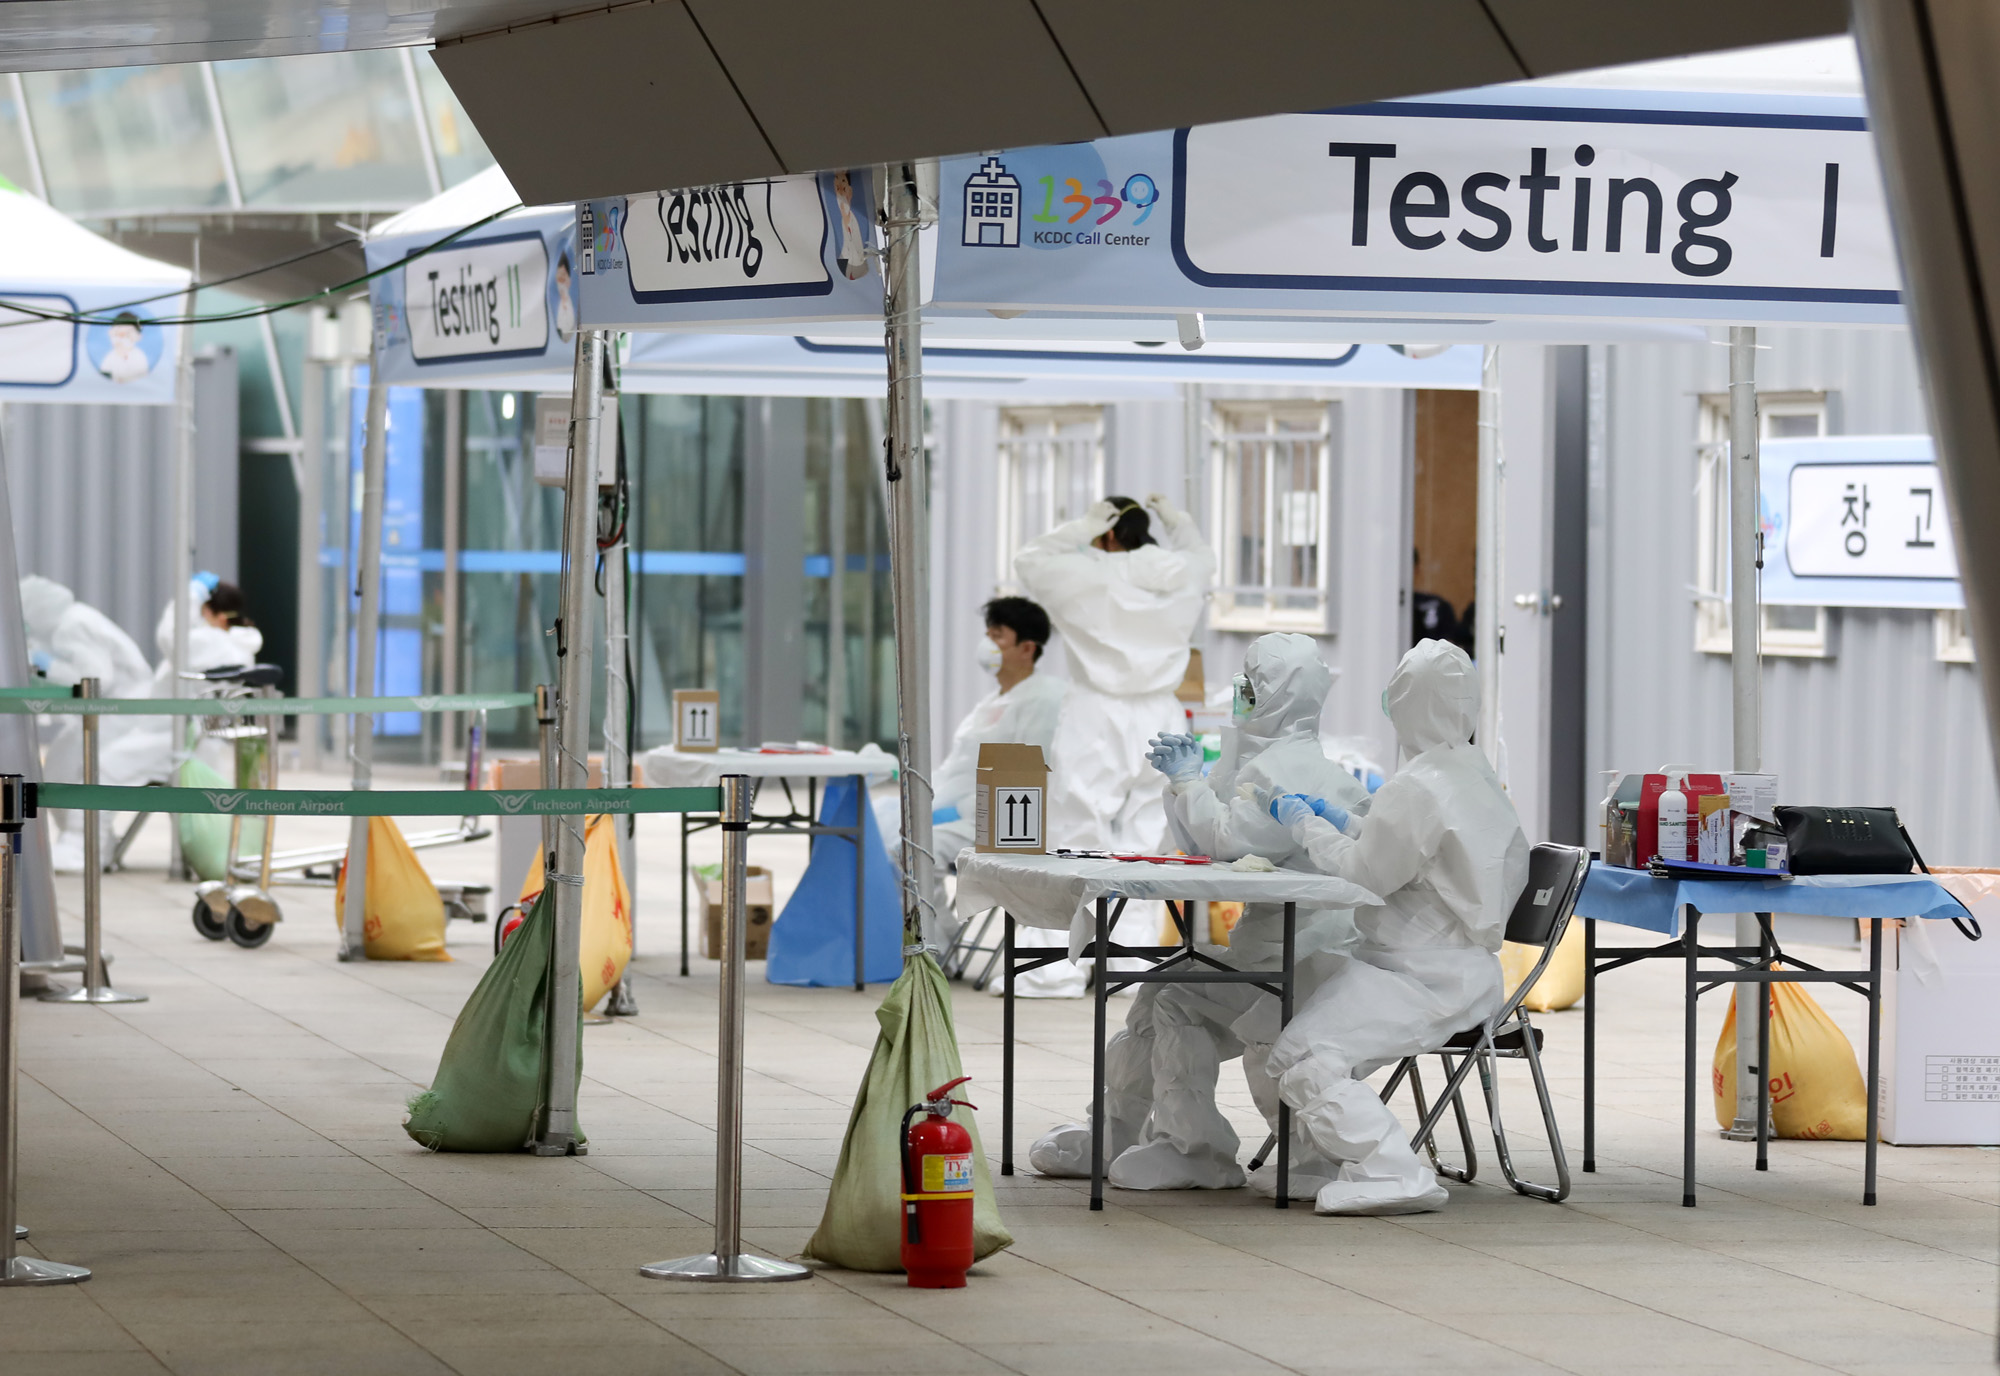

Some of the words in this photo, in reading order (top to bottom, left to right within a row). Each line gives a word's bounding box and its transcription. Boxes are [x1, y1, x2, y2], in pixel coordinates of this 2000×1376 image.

[1032, 173, 1160, 227] 1339
[1328, 142, 1740, 278] Testing
[1034, 231, 1073, 245] KCDC
[1076, 231, 1101, 245] Call
[1104, 232, 1151, 246] Center
[428, 262, 500, 345] Testing
[245, 798, 296, 812] Incheon
[298, 798, 345, 814] Airport
[533, 798, 583, 812] Incheon
[586, 797, 631, 813] Airport
